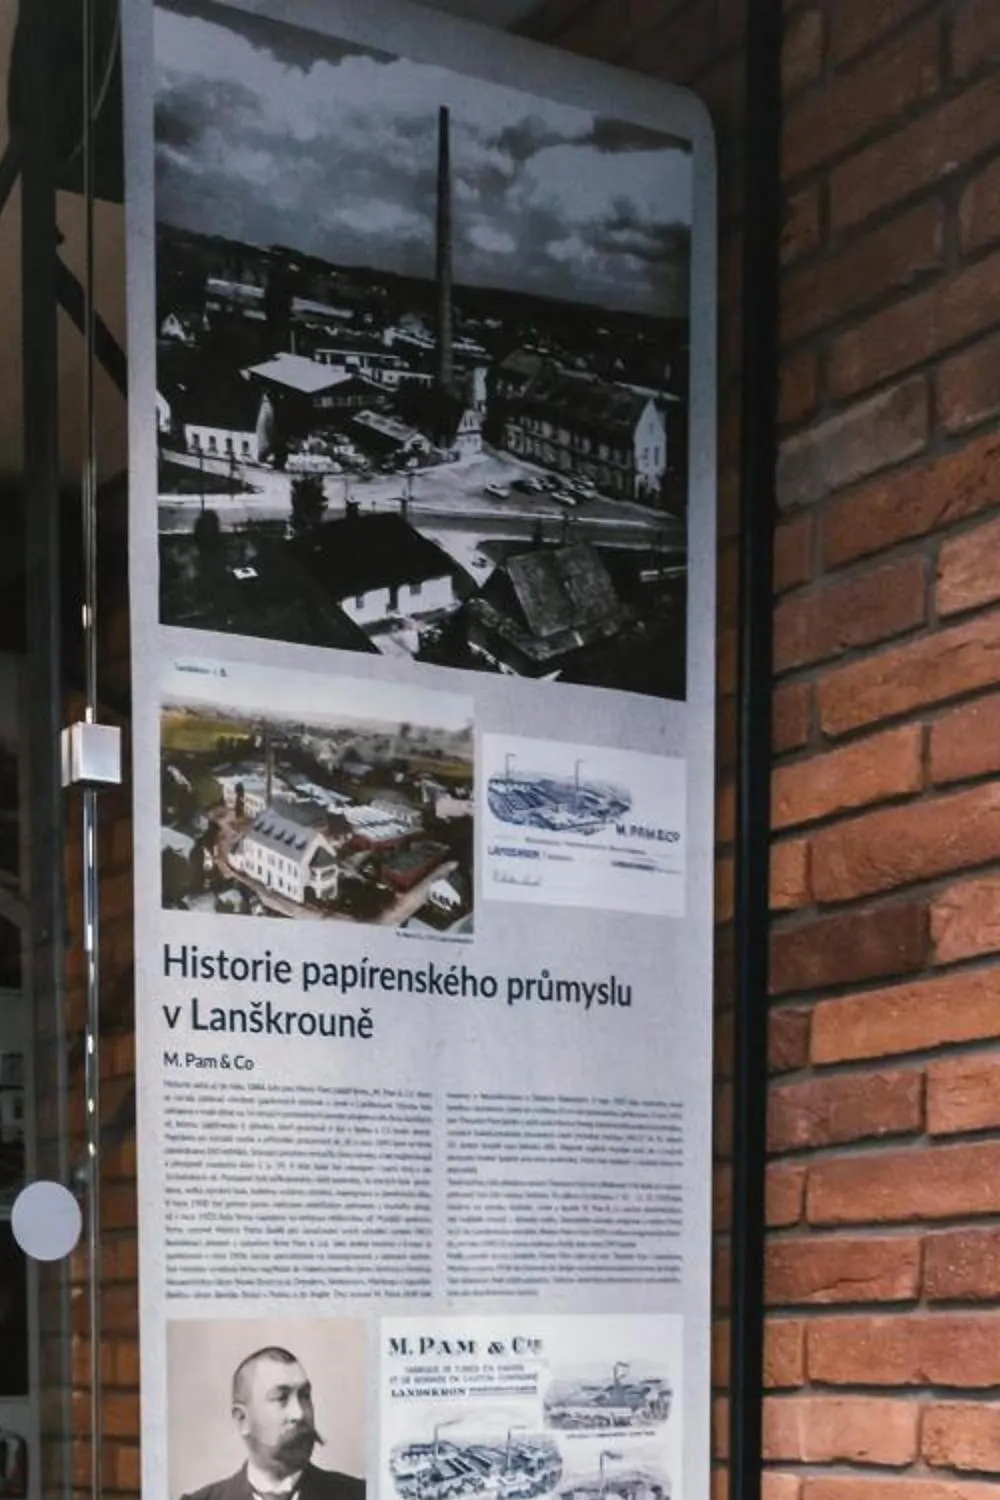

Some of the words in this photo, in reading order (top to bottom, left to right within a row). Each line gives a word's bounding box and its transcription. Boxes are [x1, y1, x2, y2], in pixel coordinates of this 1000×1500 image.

[162, 944, 292, 984] Historie
[302, 957, 498, 998] papírenského
[506, 970, 633, 1009] průmyslu
[162, 1006, 180, 1029] v
[191, 998, 374, 1039] Lanškrouně
[163, 1051, 182, 1067] M.
[185, 1052, 217, 1069] Pam
[220, 1053, 231, 1069] &
[233, 1055, 255, 1071] Co
[389, 1337, 413, 1355] M.
[420, 1337, 475, 1355] PAM
[487, 1341, 505, 1355] &
